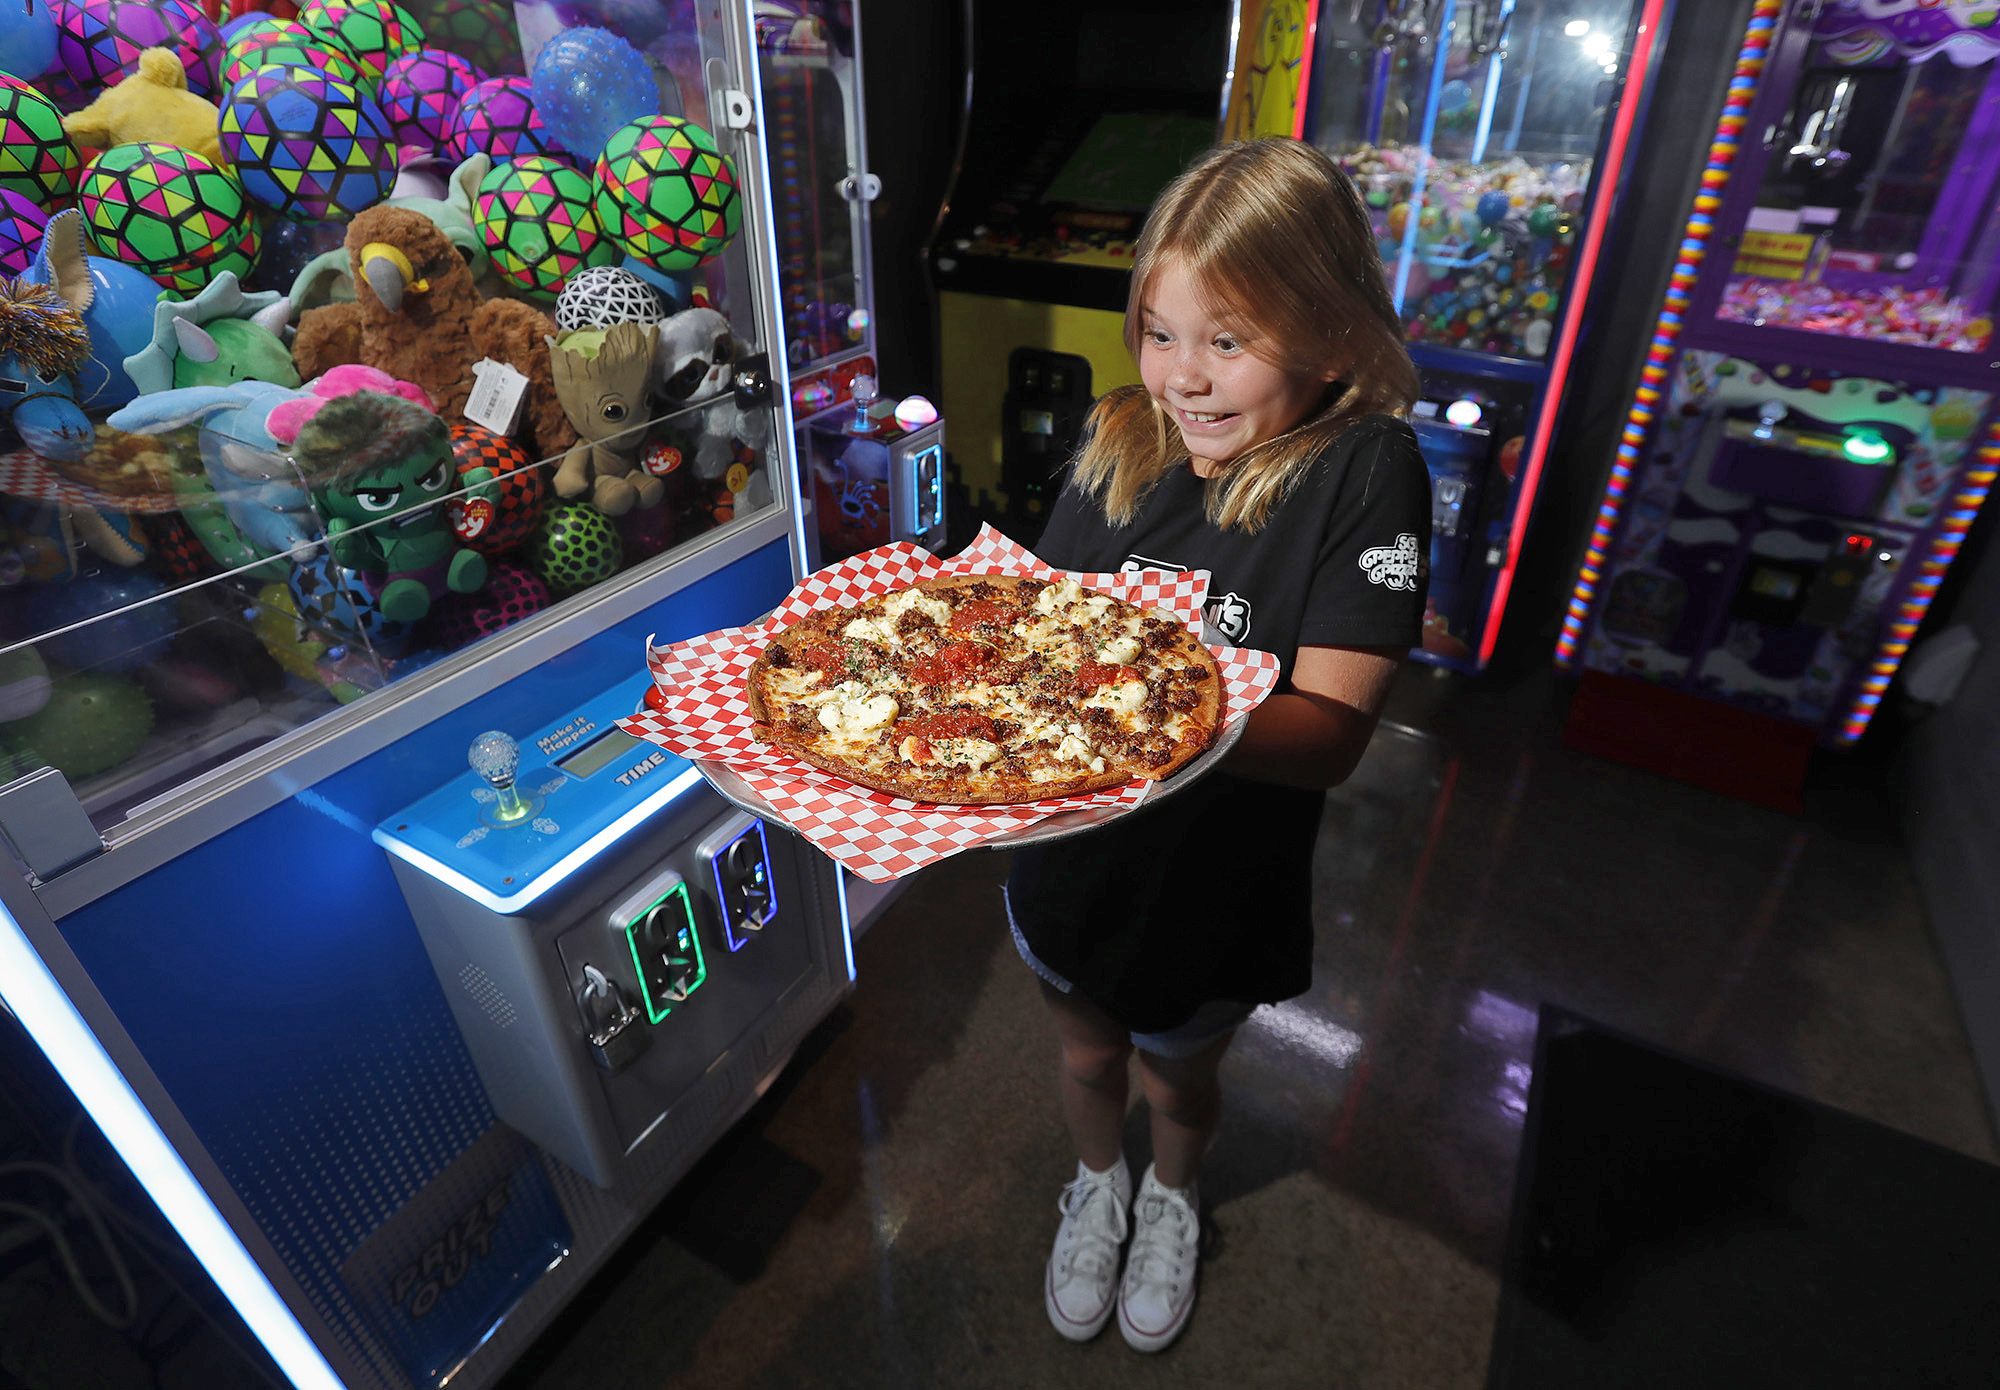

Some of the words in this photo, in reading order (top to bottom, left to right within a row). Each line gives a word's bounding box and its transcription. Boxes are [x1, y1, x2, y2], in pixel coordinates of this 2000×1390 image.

[448, 508, 485, 538] ty
[1398, 536, 1418, 551] SG
[536, 724, 575, 749] Make
[573, 715, 587, 727] it
[542, 722, 597, 756] Happen
[614, 751, 668, 787] TIME
[392, 1175, 510, 1306] PRIZE
[410, 1215, 499, 1320] OUT
